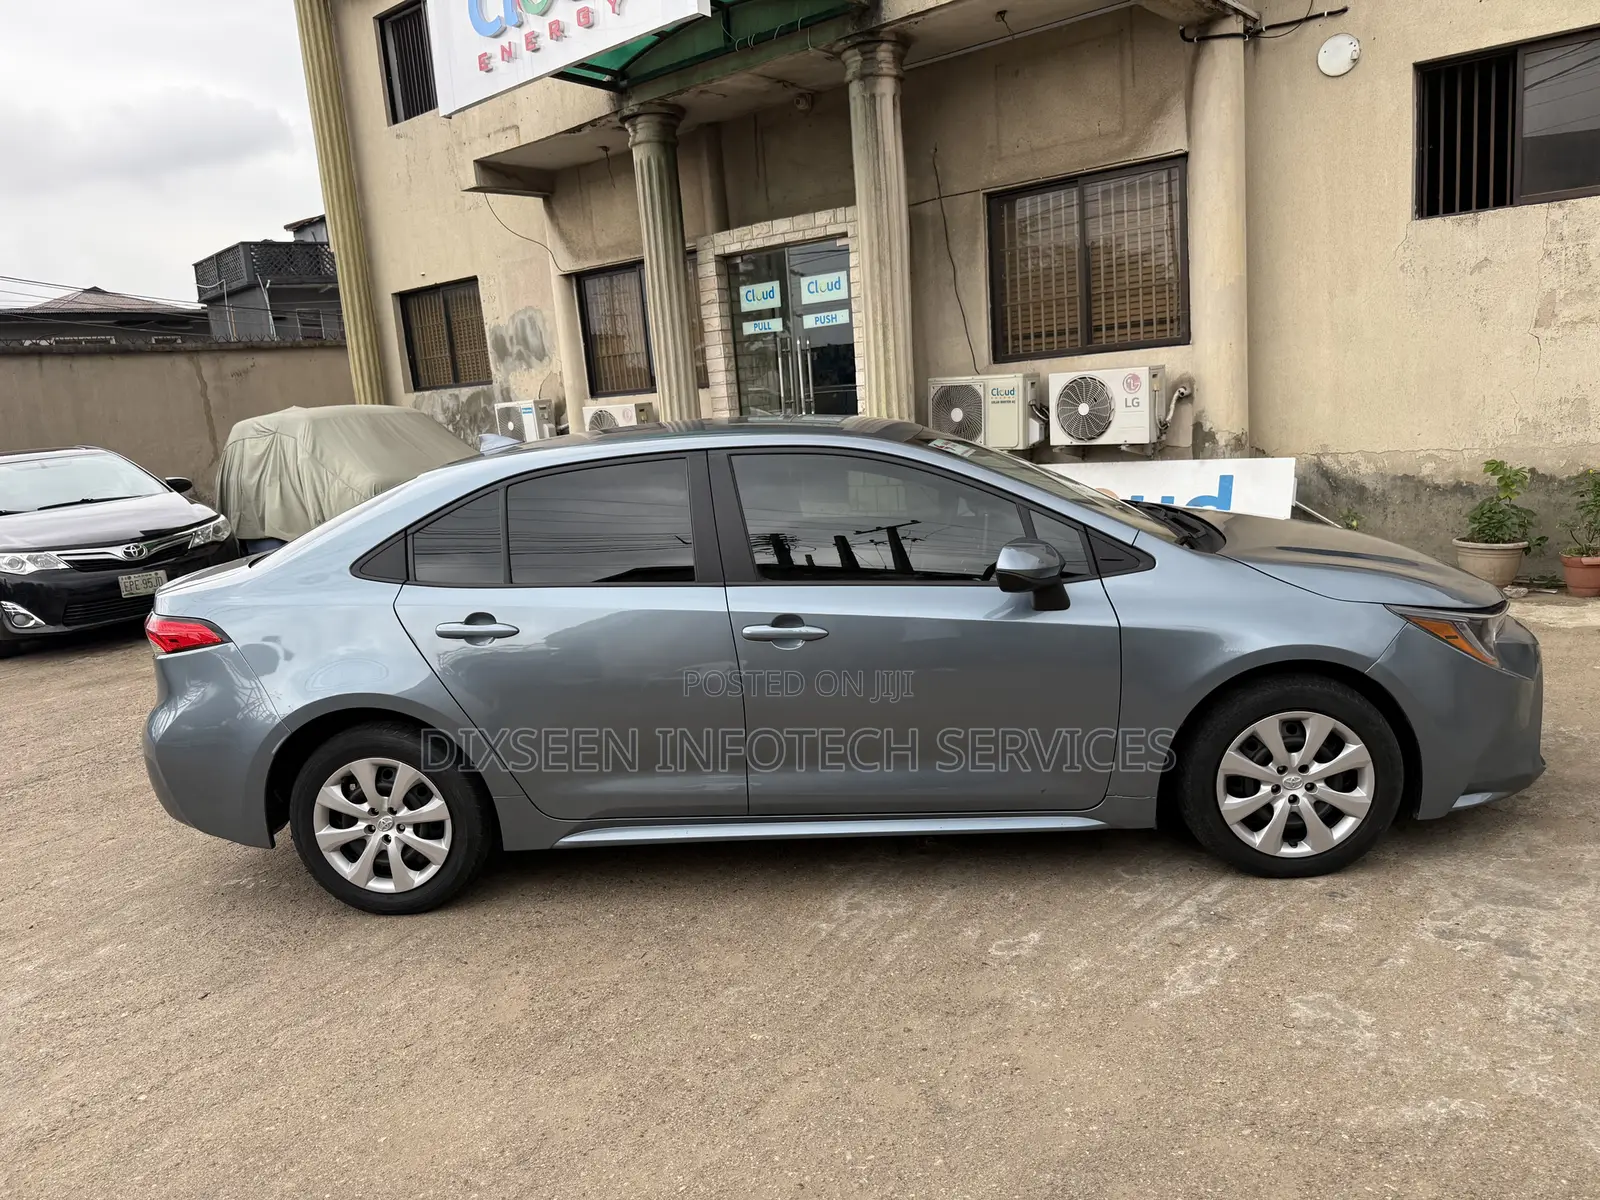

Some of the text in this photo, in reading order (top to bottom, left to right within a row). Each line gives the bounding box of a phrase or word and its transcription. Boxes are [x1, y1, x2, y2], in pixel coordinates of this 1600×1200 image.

[477, 0, 621, 72] ENERGY
[807, 276, 841, 294] Cloud
[745, 286, 775, 302] Cloud
[814, 314, 838, 325] PUSH
[753, 321, 772, 331] PULL
[991, 387, 1015, 396] Cloud
[1125, 397, 1140, 408] LG
